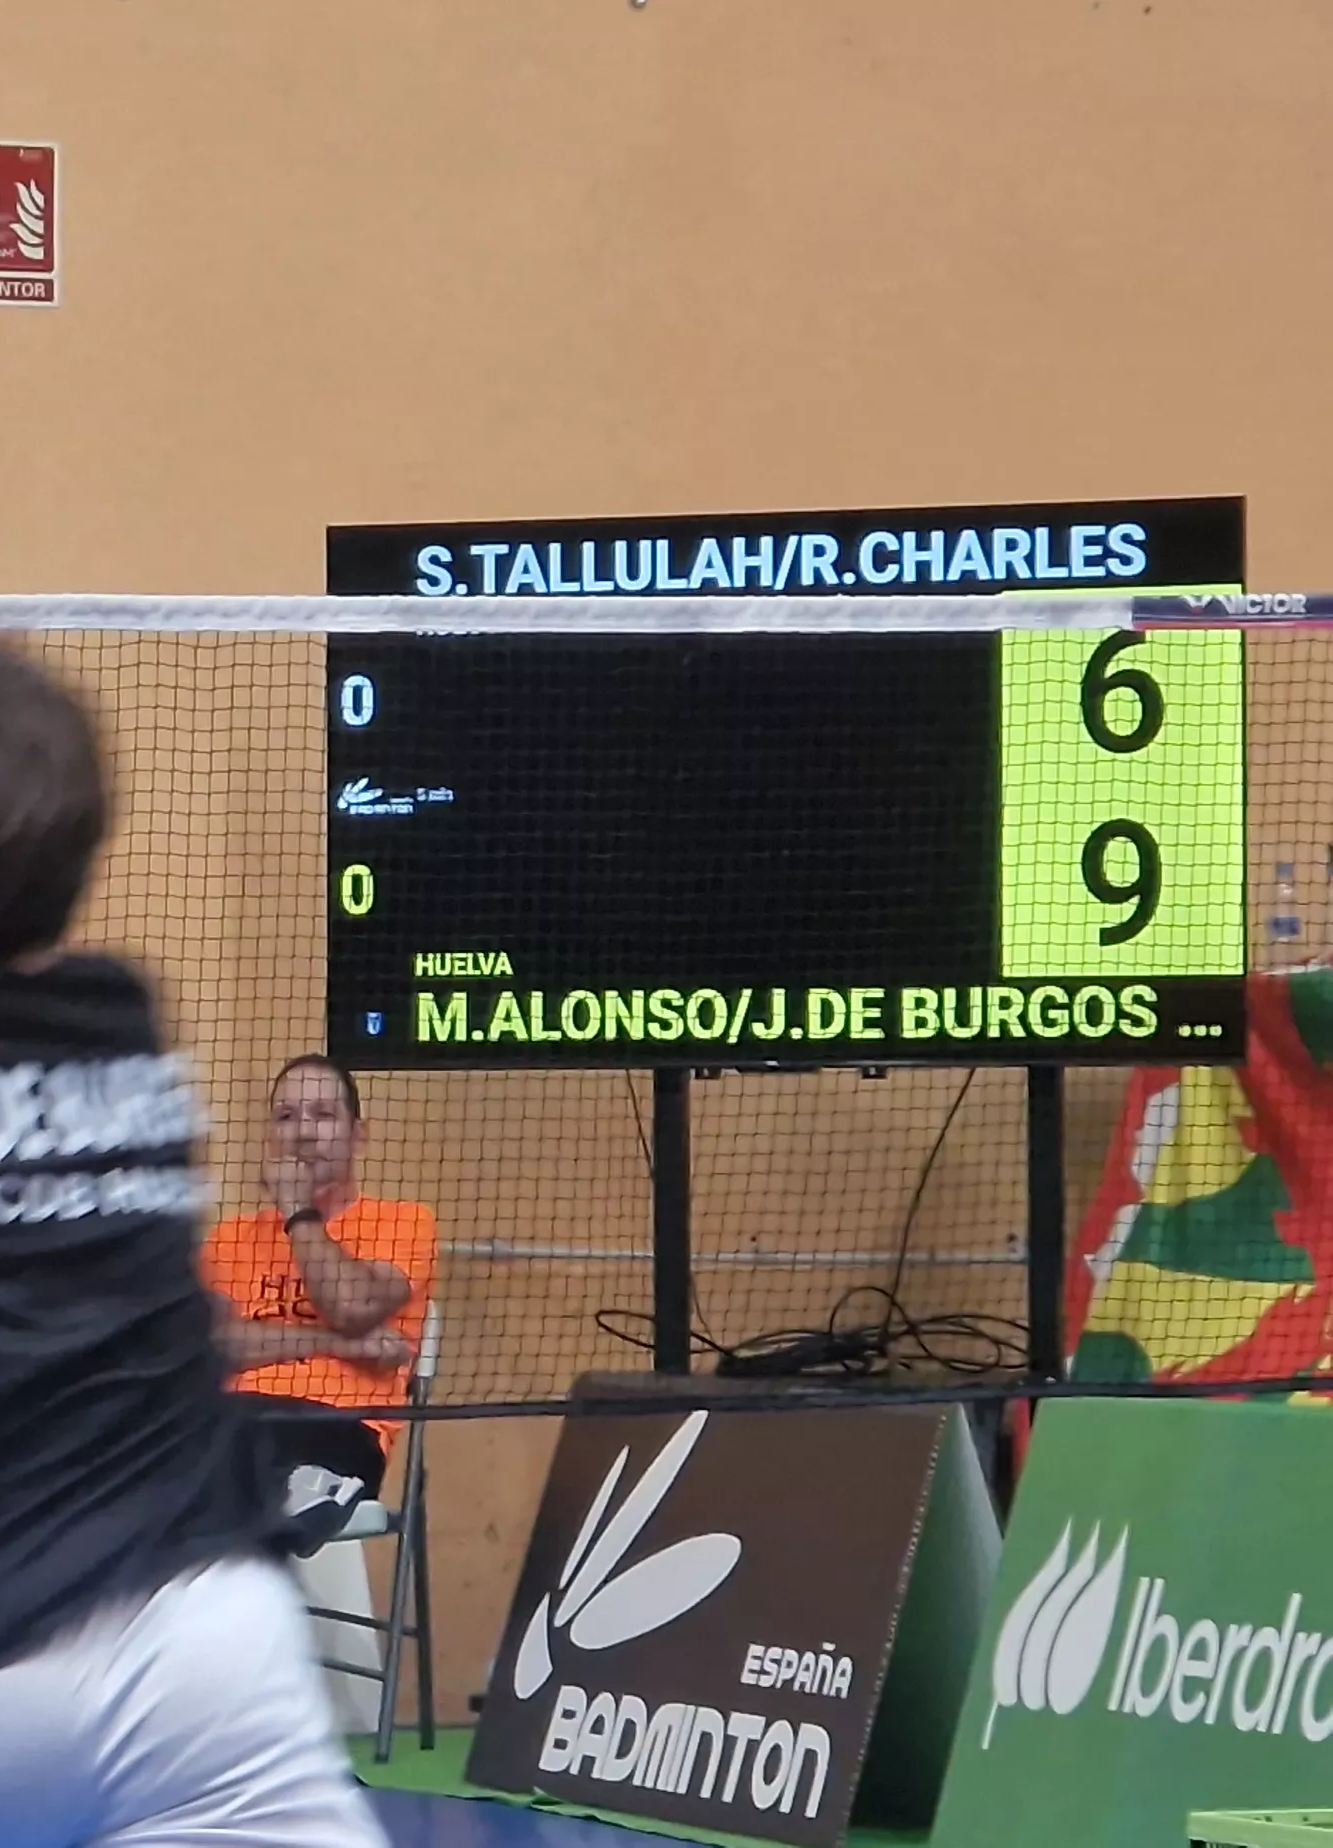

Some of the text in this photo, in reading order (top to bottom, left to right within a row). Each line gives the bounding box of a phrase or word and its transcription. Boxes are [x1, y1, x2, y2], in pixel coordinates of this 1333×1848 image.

[415, 523, 1148, 596] S.TALLULAH/R.CHARLES
[1215, 593, 1307, 615] VICTOR
[1081, 629, 1164, 754] 6
[1082, 818, 1162, 946] 9
[415, 952, 514, 977] HUELVA
[416, 986, 886, 1044] M.ALONSO/J.DE
[899, 985, 1159, 1039] BURGOS
[739, 1641, 853, 1699] ESPAÑA
[538, 1685, 831, 1819] BADMINTON
